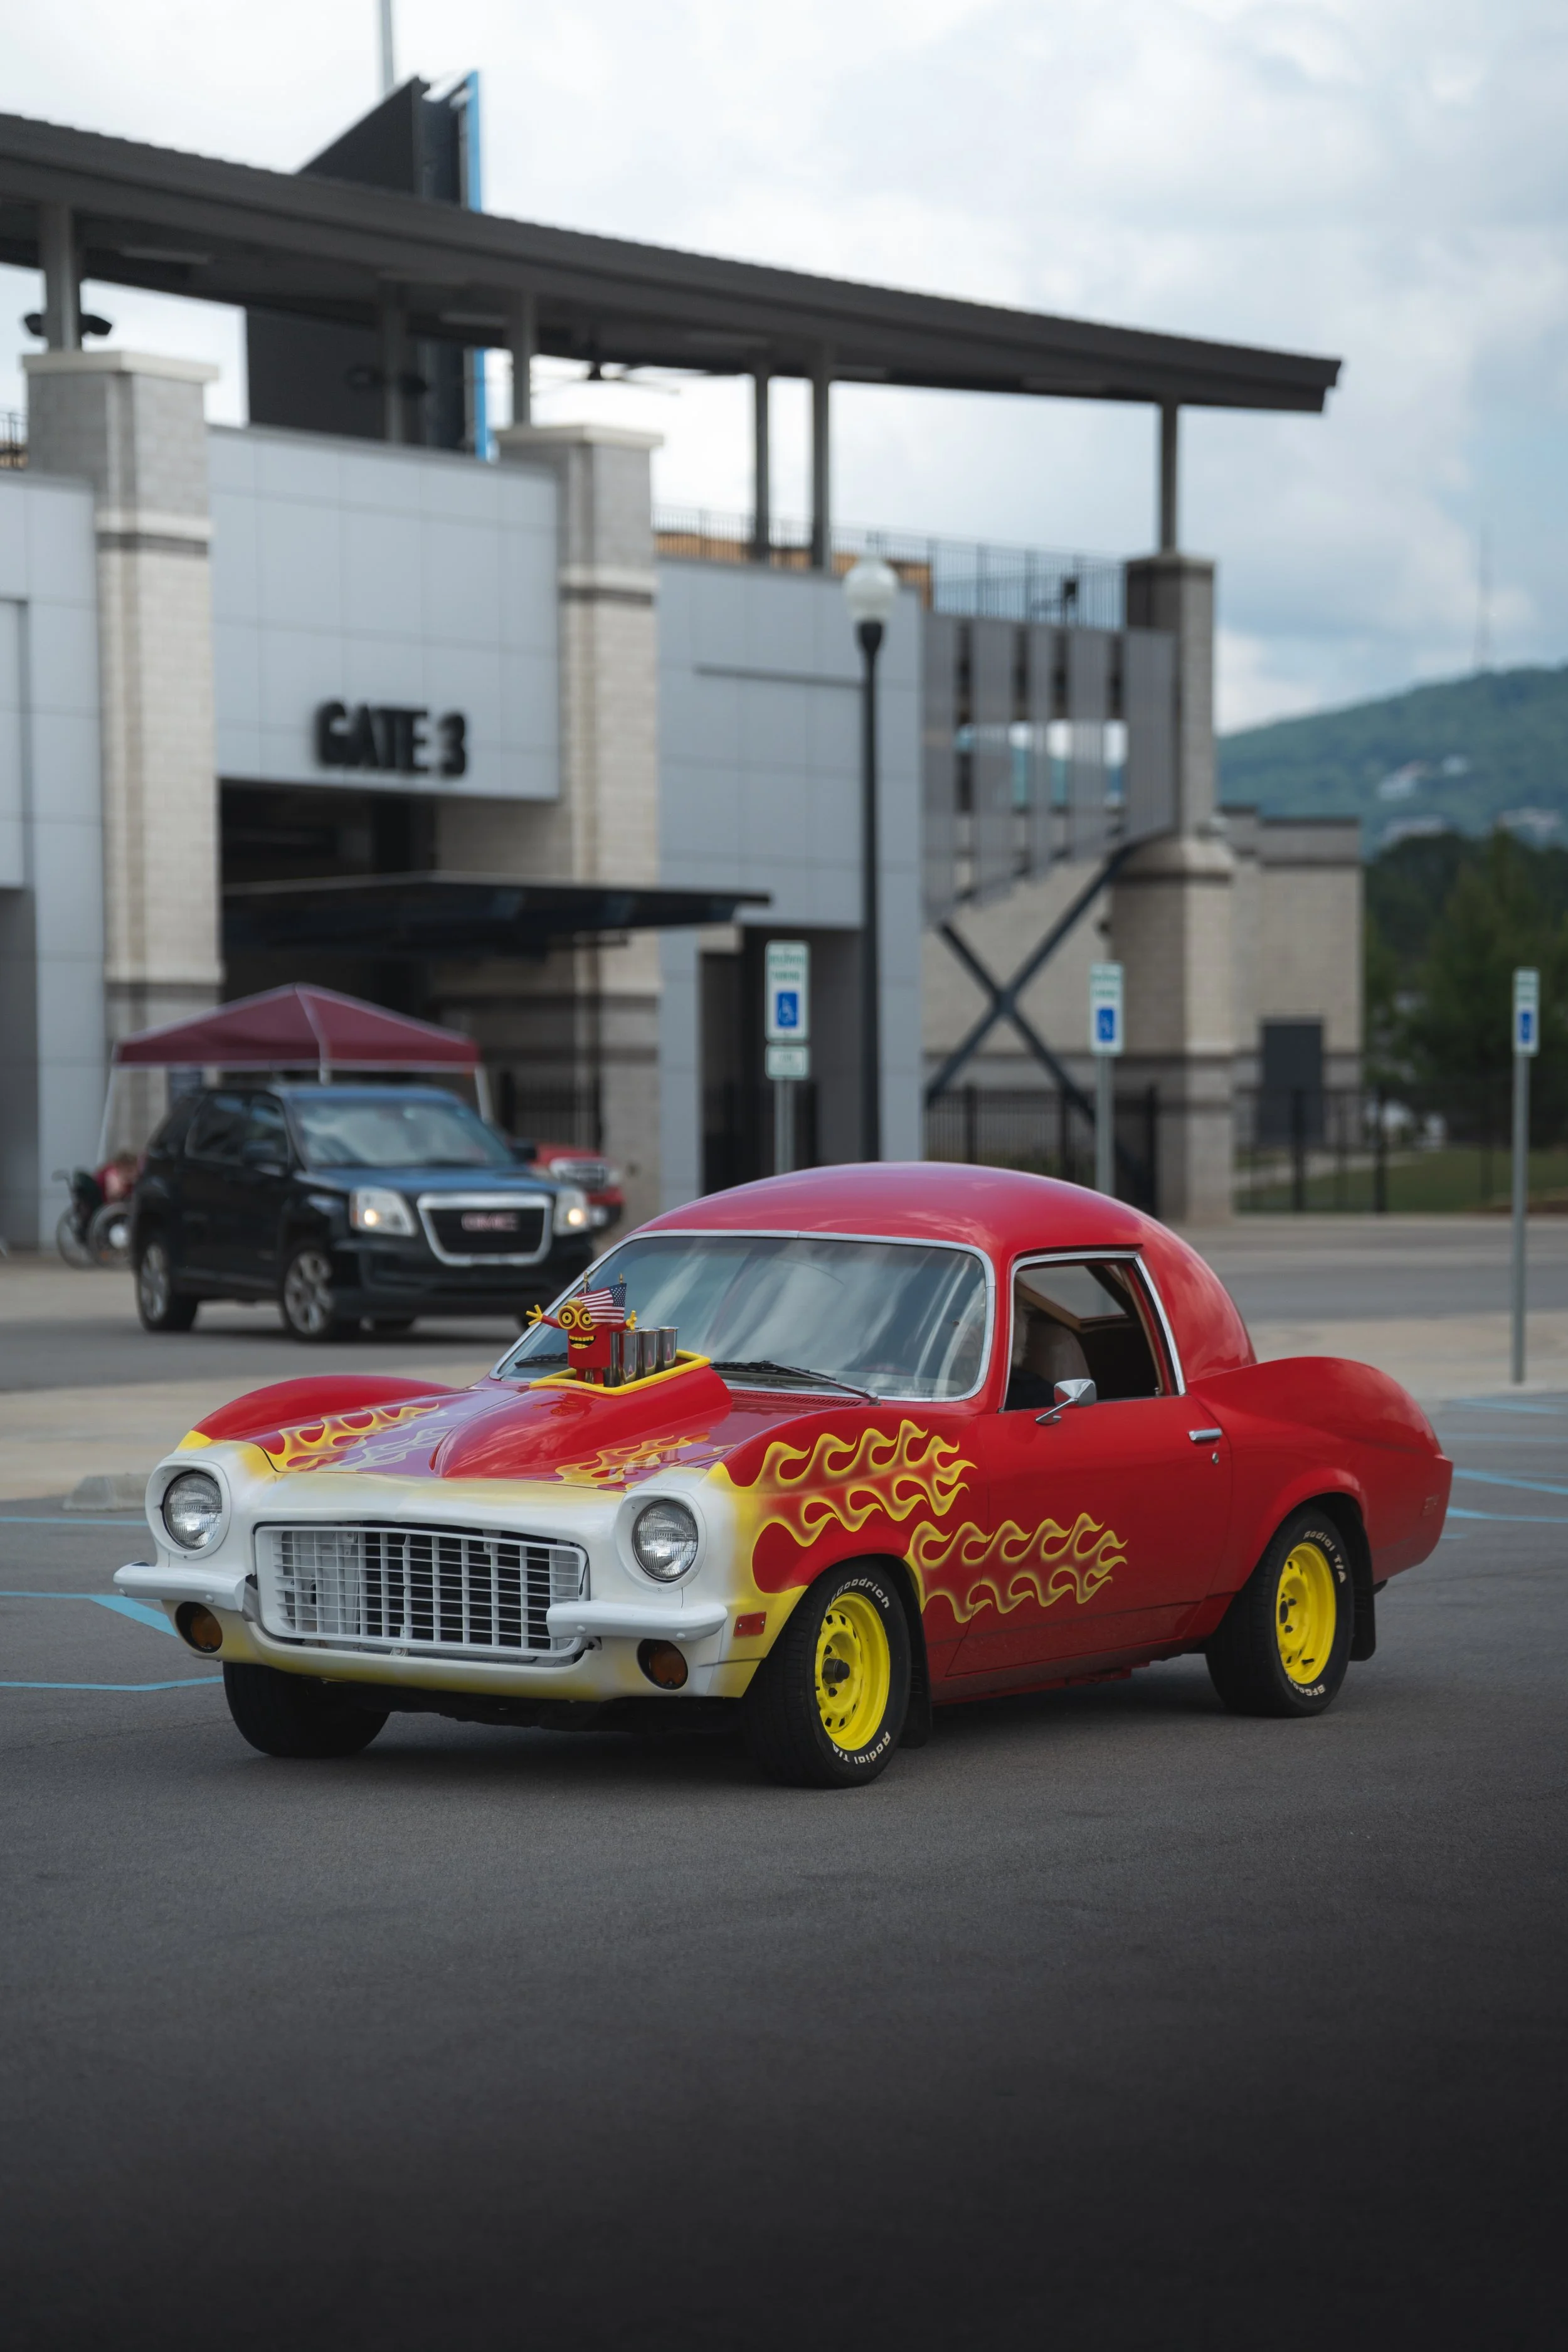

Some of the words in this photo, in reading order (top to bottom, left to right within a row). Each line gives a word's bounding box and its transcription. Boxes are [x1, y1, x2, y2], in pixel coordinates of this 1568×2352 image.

[315, 699, 429, 775] GATE
[438, 711, 467, 778] 3
[1303, 1531, 1337, 1552] Radial
[854, 1731, 891, 1765] Radial
